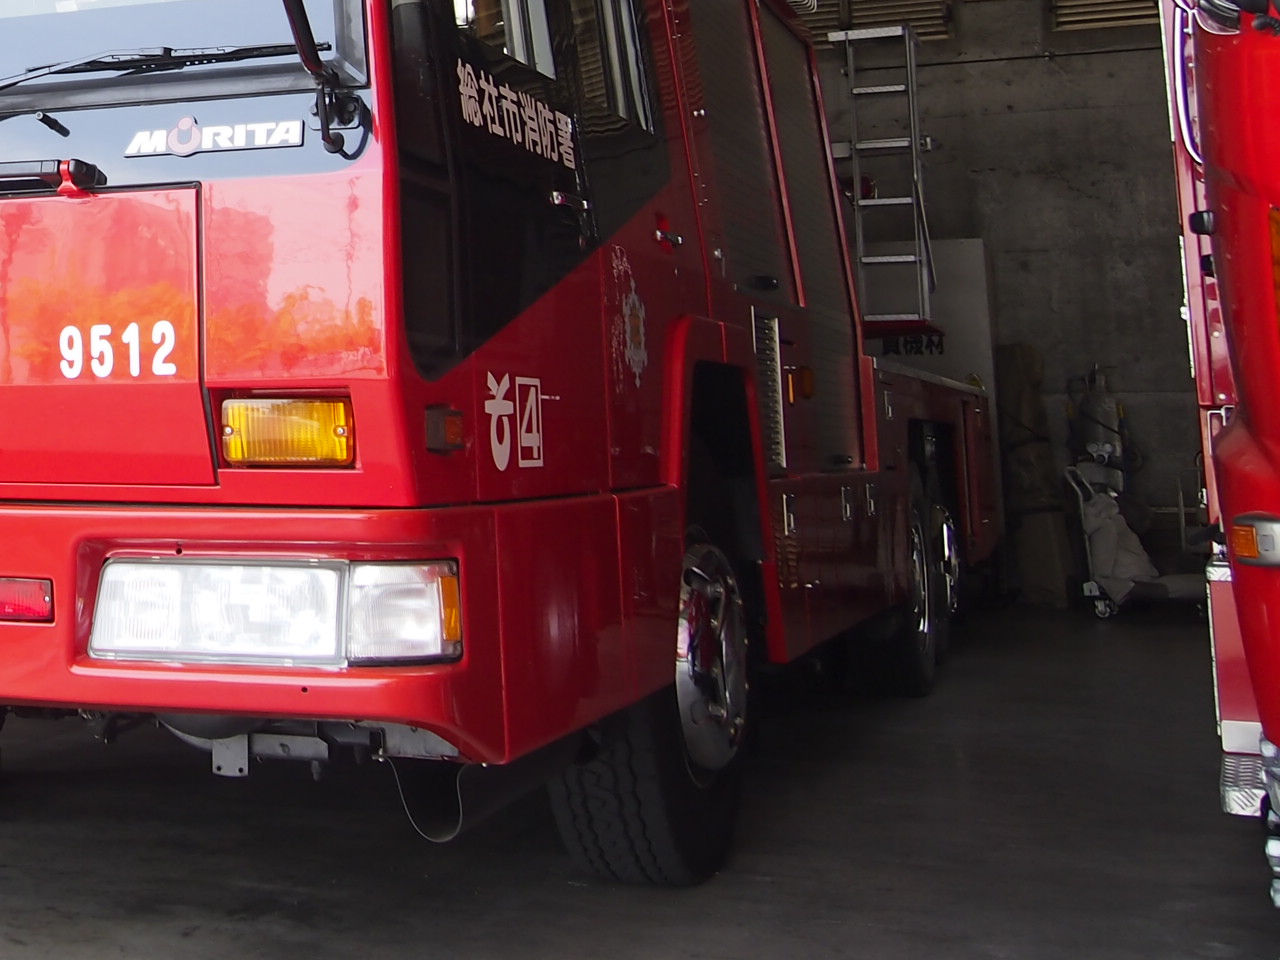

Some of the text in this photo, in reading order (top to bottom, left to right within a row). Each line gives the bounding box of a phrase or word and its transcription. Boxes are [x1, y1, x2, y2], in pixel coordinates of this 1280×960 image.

[124, 116, 303, 157] MORITA
[457, 58, 576, 169] 総社市消防署
[60, 320, 177, 378] 9512
